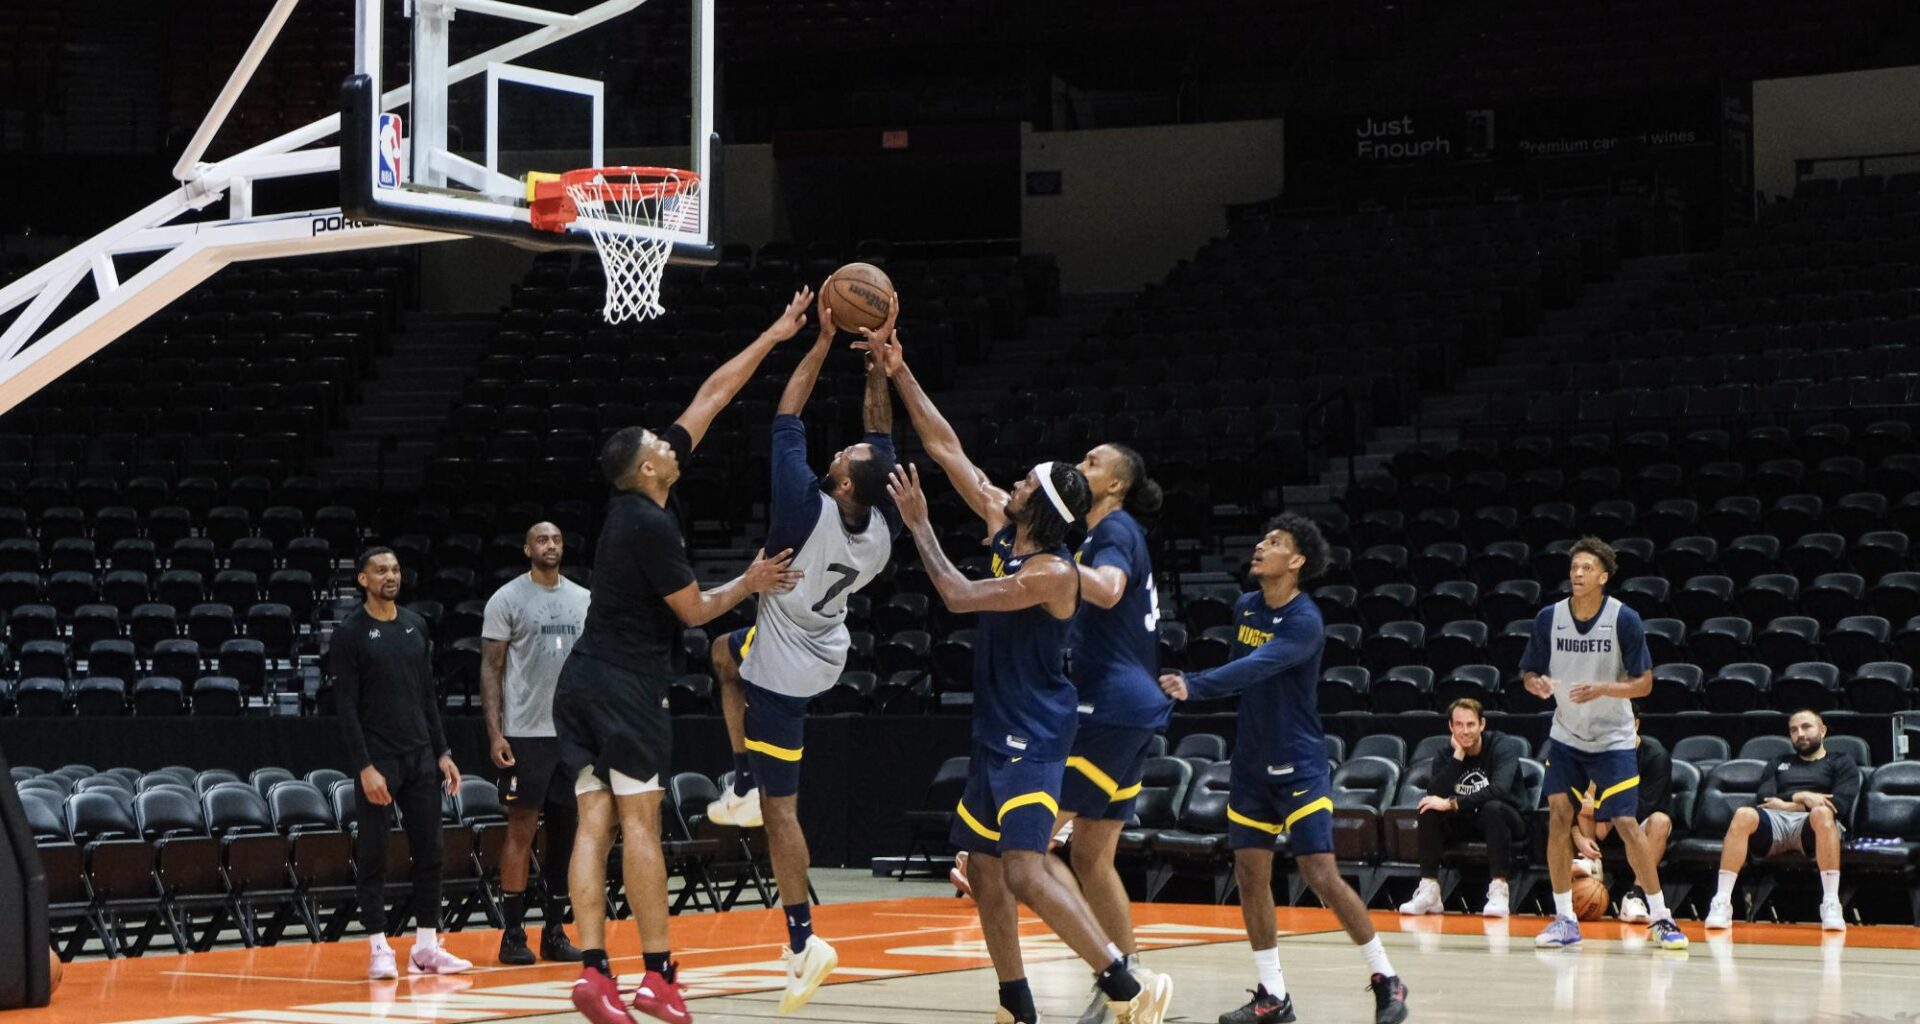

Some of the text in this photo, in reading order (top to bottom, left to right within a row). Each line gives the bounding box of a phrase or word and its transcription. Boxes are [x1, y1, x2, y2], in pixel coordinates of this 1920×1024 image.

[1356, 114, 1415, 138] Just
[1651, 130, 1696, 144] wines
[1357, 136, 1450, 159] Enough
[812, 563, 860, 612] 7
[1556, 637, 1612, 653] NUGGETS
